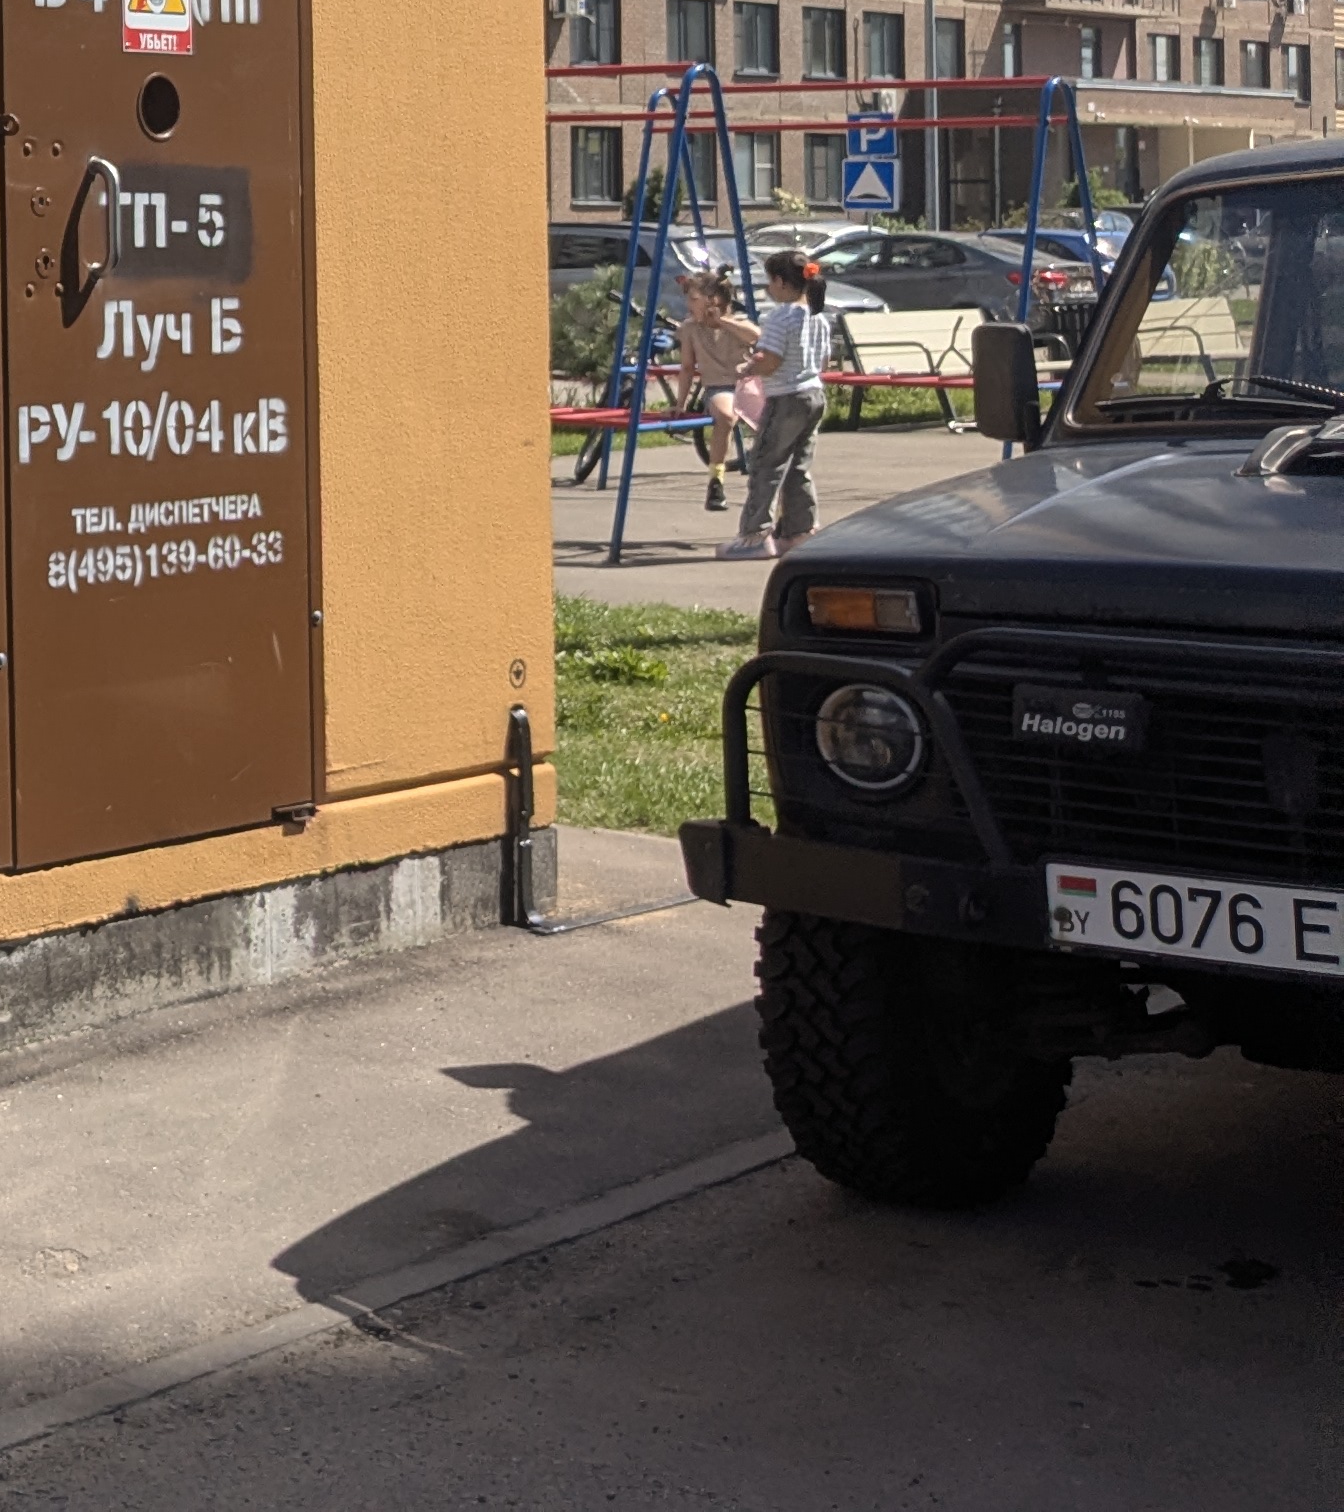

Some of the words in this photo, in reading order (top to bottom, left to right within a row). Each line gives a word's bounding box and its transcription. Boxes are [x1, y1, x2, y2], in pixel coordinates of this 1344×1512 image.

[859, 117, 887, 152] P
[96, 299, 191, 372] Луч
[211, 297, 243, 354] Б
[233, 398, 288, 455] кВ
[71, 506, 122, 534] ТЕЛ.
[128, 493, 261, 534] ДИСПЕТЧЕРА
[1021, 713, 1125, 741] Halogen
[1059, 908, 1090, 935] BY
[1111, 879, 1264, 955] 6076
